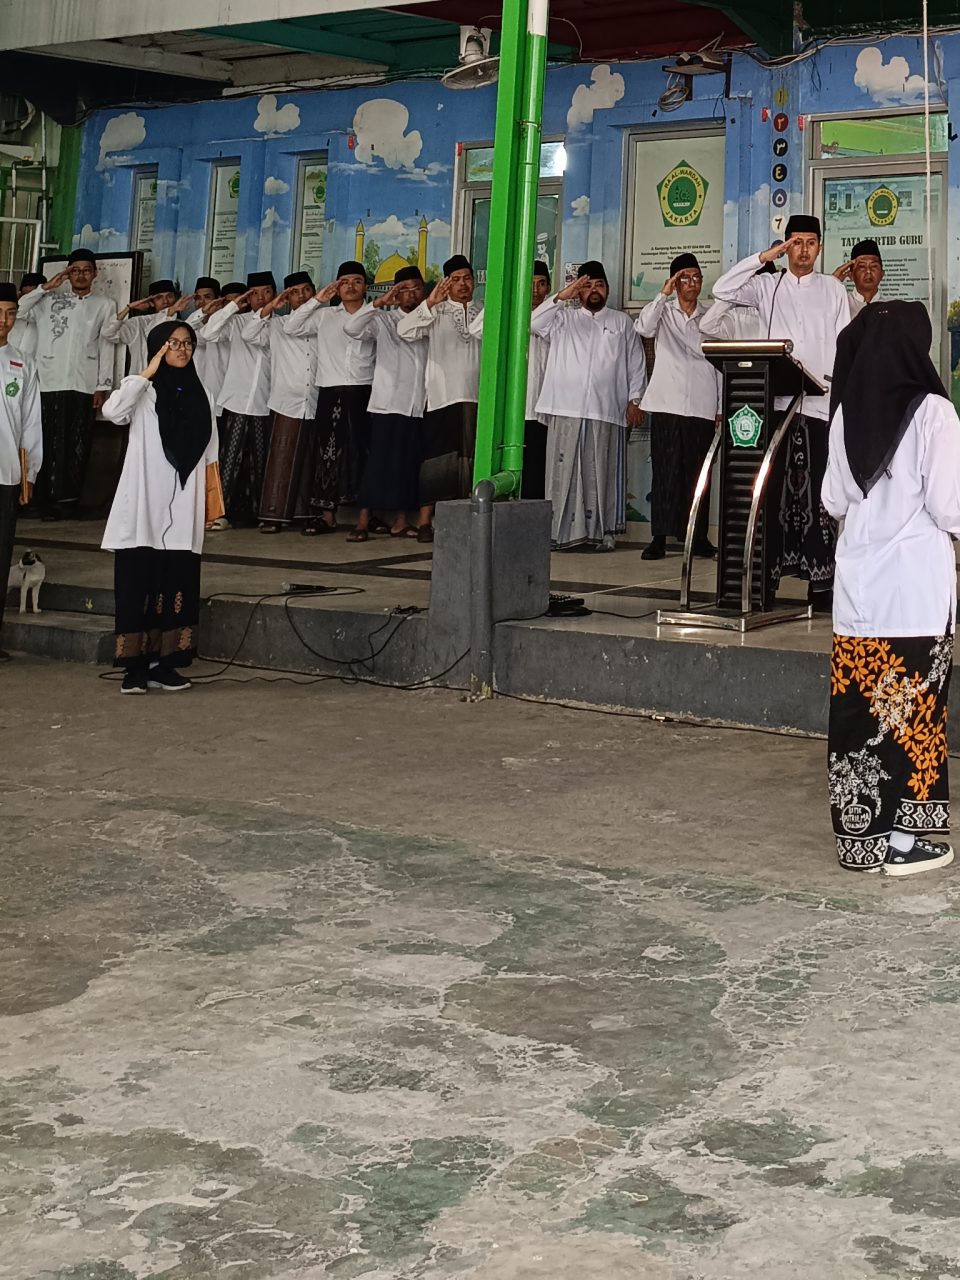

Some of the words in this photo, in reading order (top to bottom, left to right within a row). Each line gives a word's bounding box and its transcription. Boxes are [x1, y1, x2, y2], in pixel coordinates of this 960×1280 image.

[671, 169, 701, 188] AL-WARDAH
[665, 208, 698, 224] JAKARTA
[841, 237, 860, 246] TATA
[900, 235, 924, 245] GURU
